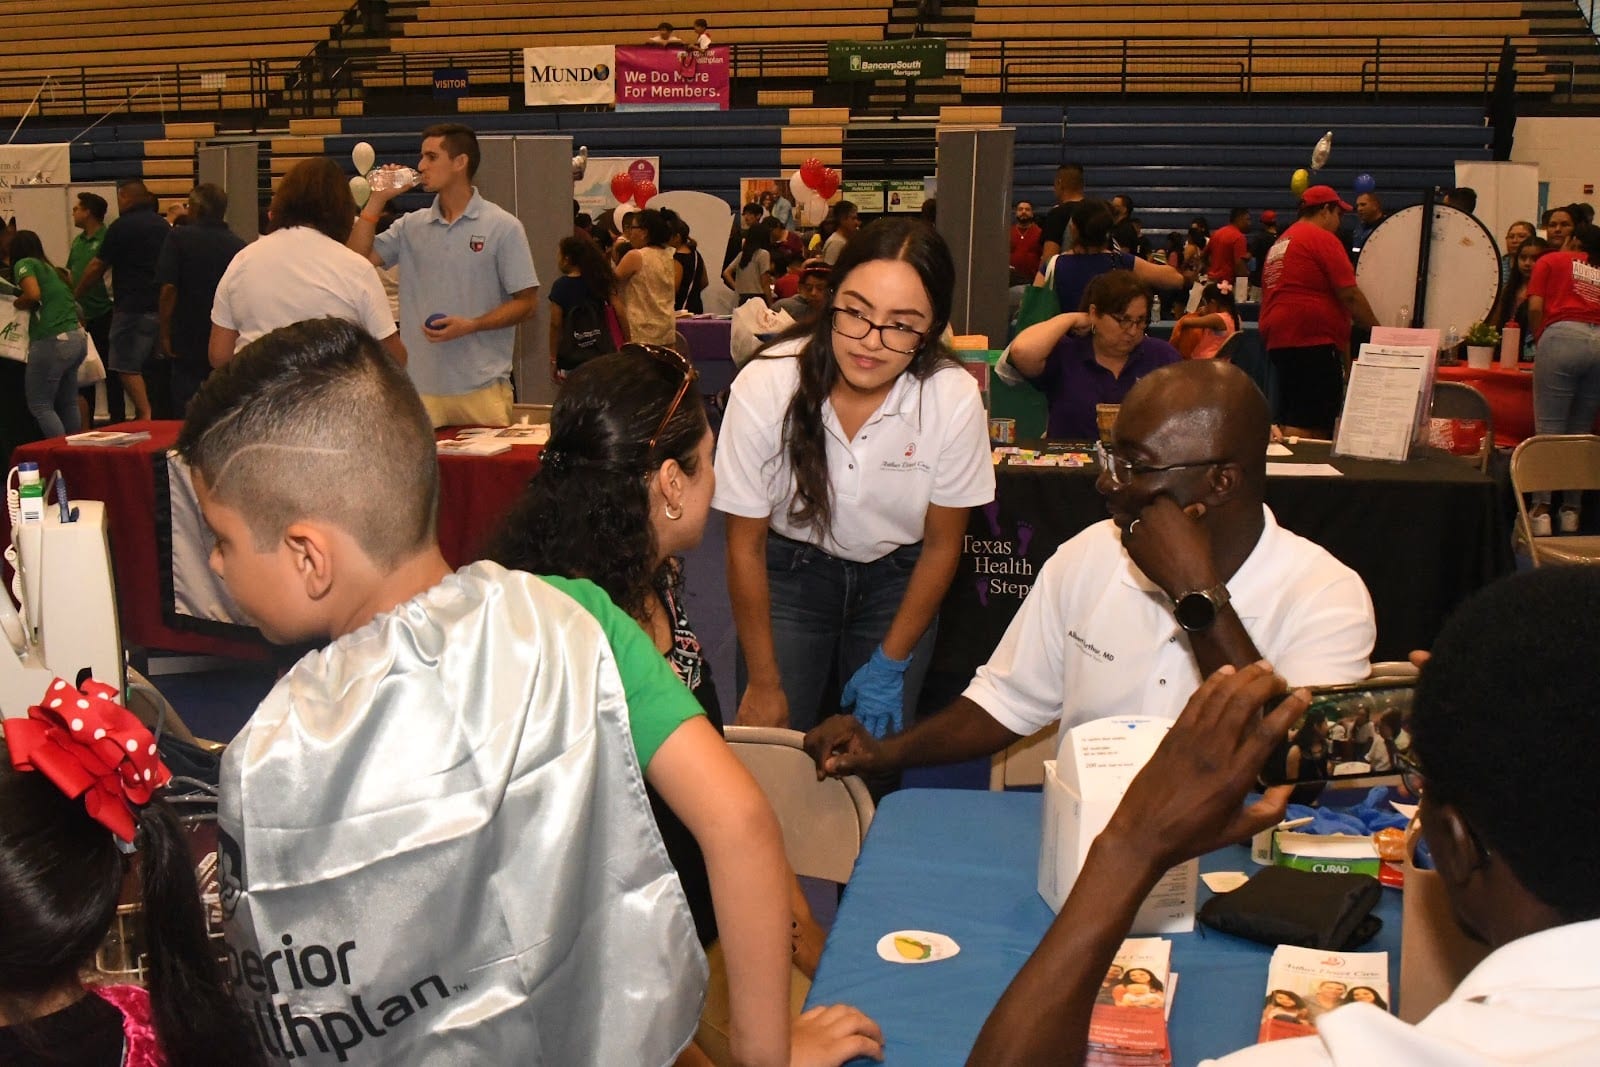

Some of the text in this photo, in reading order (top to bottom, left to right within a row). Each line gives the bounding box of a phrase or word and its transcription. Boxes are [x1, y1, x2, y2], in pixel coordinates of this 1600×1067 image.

[861, 60, 921, 72] BancorpSouth
[624, 70, 709, 83] We Do Mre
[434, 79, 467, 89] VISITOR
[624, 85, 721, 97] For Members.
[963, 535, 1012, 555] Texas
[975, 556, 1033, 576] Health
[1103, 651, 1114, 661] MD
[1312, 864, 1350, 874] CURAD
